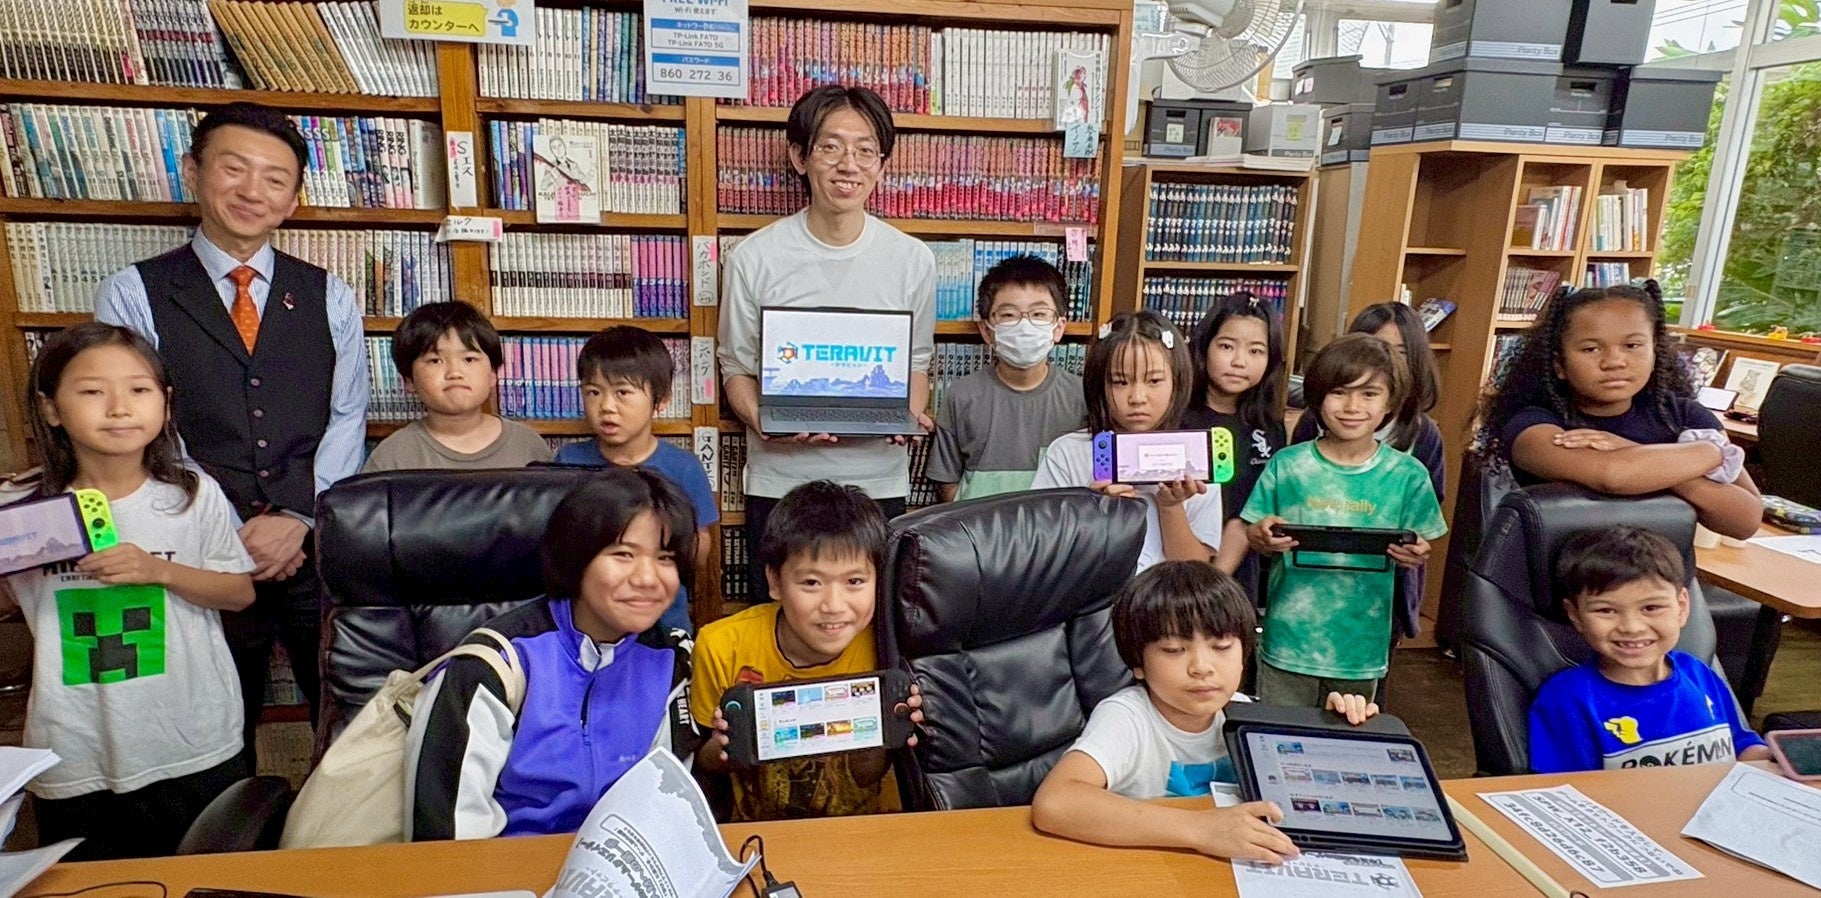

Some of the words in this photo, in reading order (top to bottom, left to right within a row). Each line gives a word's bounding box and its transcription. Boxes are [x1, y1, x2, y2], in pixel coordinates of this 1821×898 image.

[408, 3, 443, 15] 返却は
[409, 19, 480, 32] カウンターへ
[1542, 46, 1559, 55] Box
[682, 56, 710, 64] パスワード
[660, 68, 682, 79] 860
[689, 69, 711, 80] 272
[717, 71, 733, 81] 36
[1503, 127, 1528, 137] Plenty
[1529, 128, 1543, 137] Box
[801, 344, 897, 363] TERAVIT
